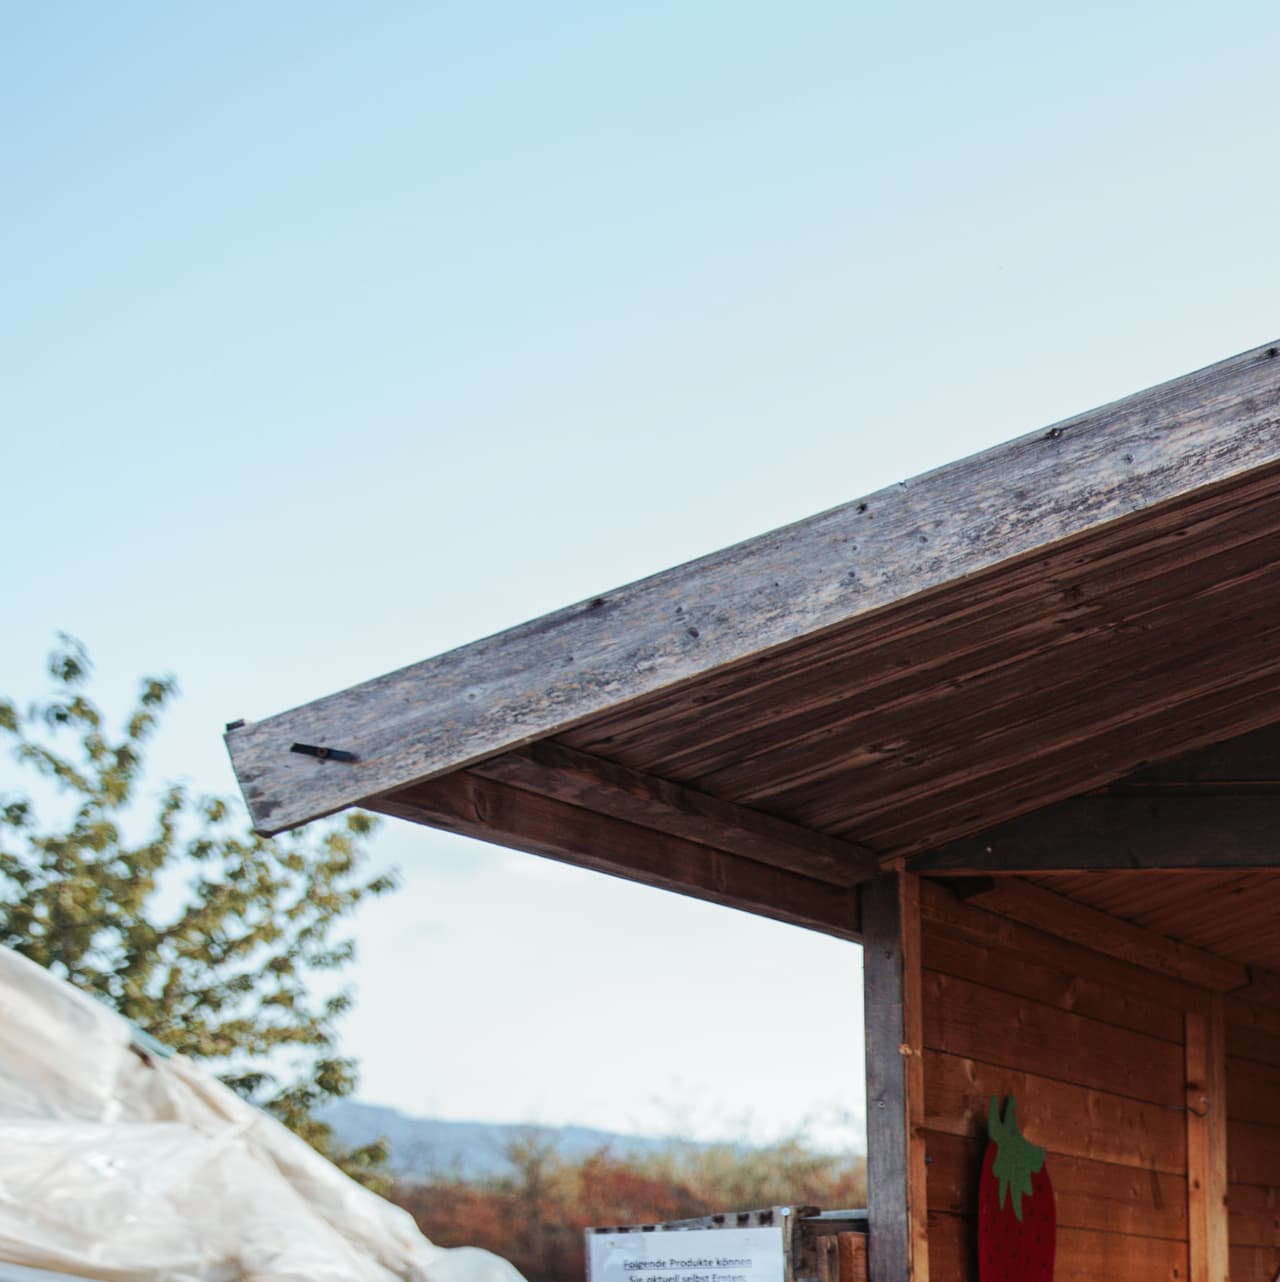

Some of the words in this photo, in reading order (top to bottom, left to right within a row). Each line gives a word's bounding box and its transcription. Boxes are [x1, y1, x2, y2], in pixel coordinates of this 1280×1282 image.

[624, 1259, 666, 1270] Folgende
[670, 1258, 712, 1268] Produkte
[716, 1257, 752, 1267] können
[682, 1274, 710, 1282] selbst
